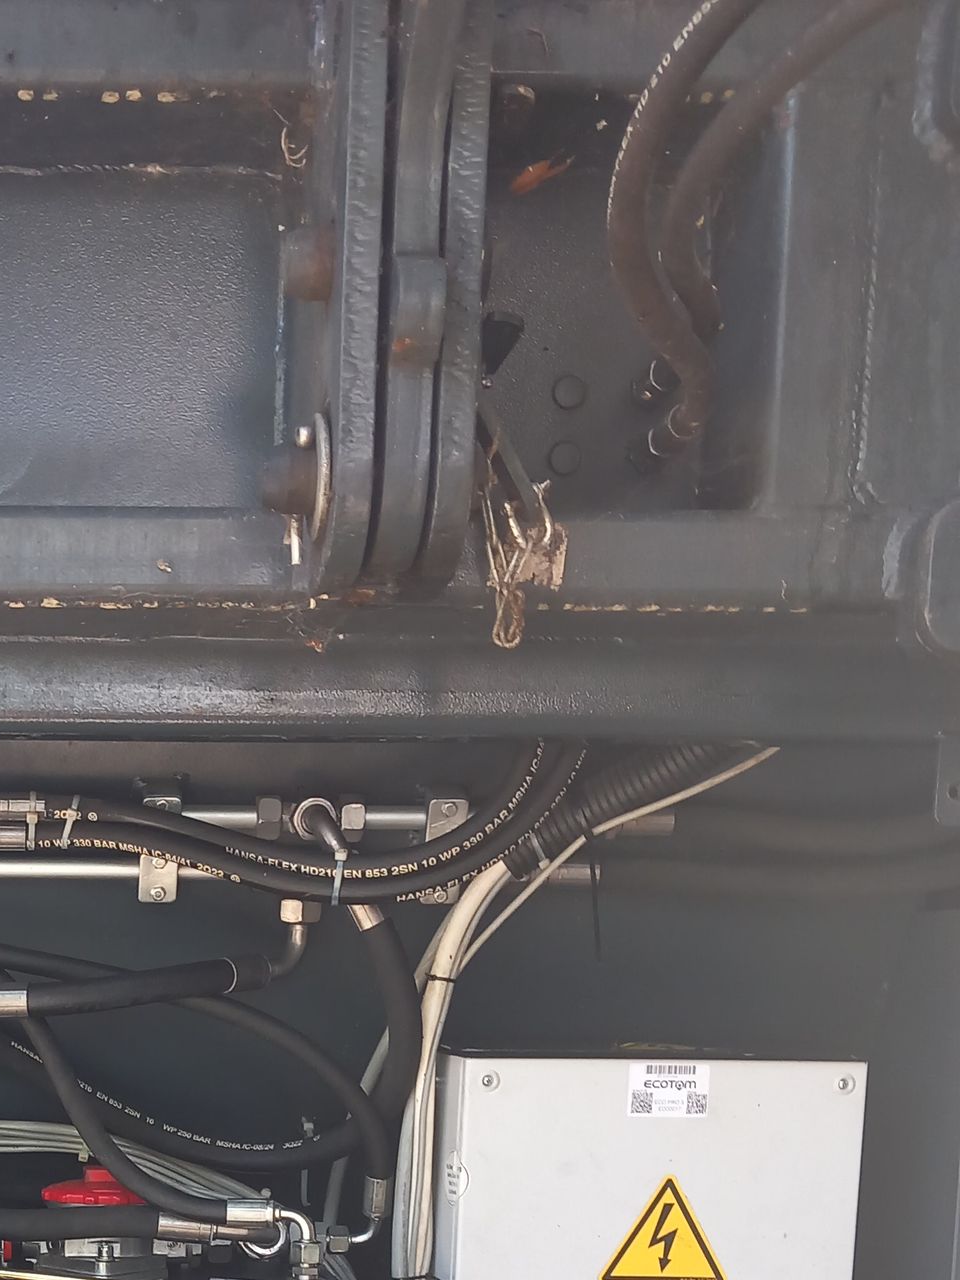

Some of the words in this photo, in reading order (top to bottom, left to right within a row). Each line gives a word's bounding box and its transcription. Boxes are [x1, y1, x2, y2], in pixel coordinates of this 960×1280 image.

[53, 809, 82, 820] 2Q2
[225, 846, 298, 873] HANSA-FLEX
[344, 869, 362, 880] EN
[365, 867, 389, 879] 853
[390, 861, 419, 877] 2SN
[420, 856, 437, 869] 10
[438, 846, 461, 863] WP
[462, 831, 484, 851] 330
[484, 809, 510, 835] BAR
[507, 775, 533, 812] MSHA
[38, 839, 51, 849] 10
[73, 838, 92, 849] 330
[93, 839, 117, 851] BAR
[118, 842, 149, 856] MSHA
[123, 1105, 141, 1119] 2SN
[162, 1123, 178, 1133] WP
[192, 1133, 212, 1146] BAR
